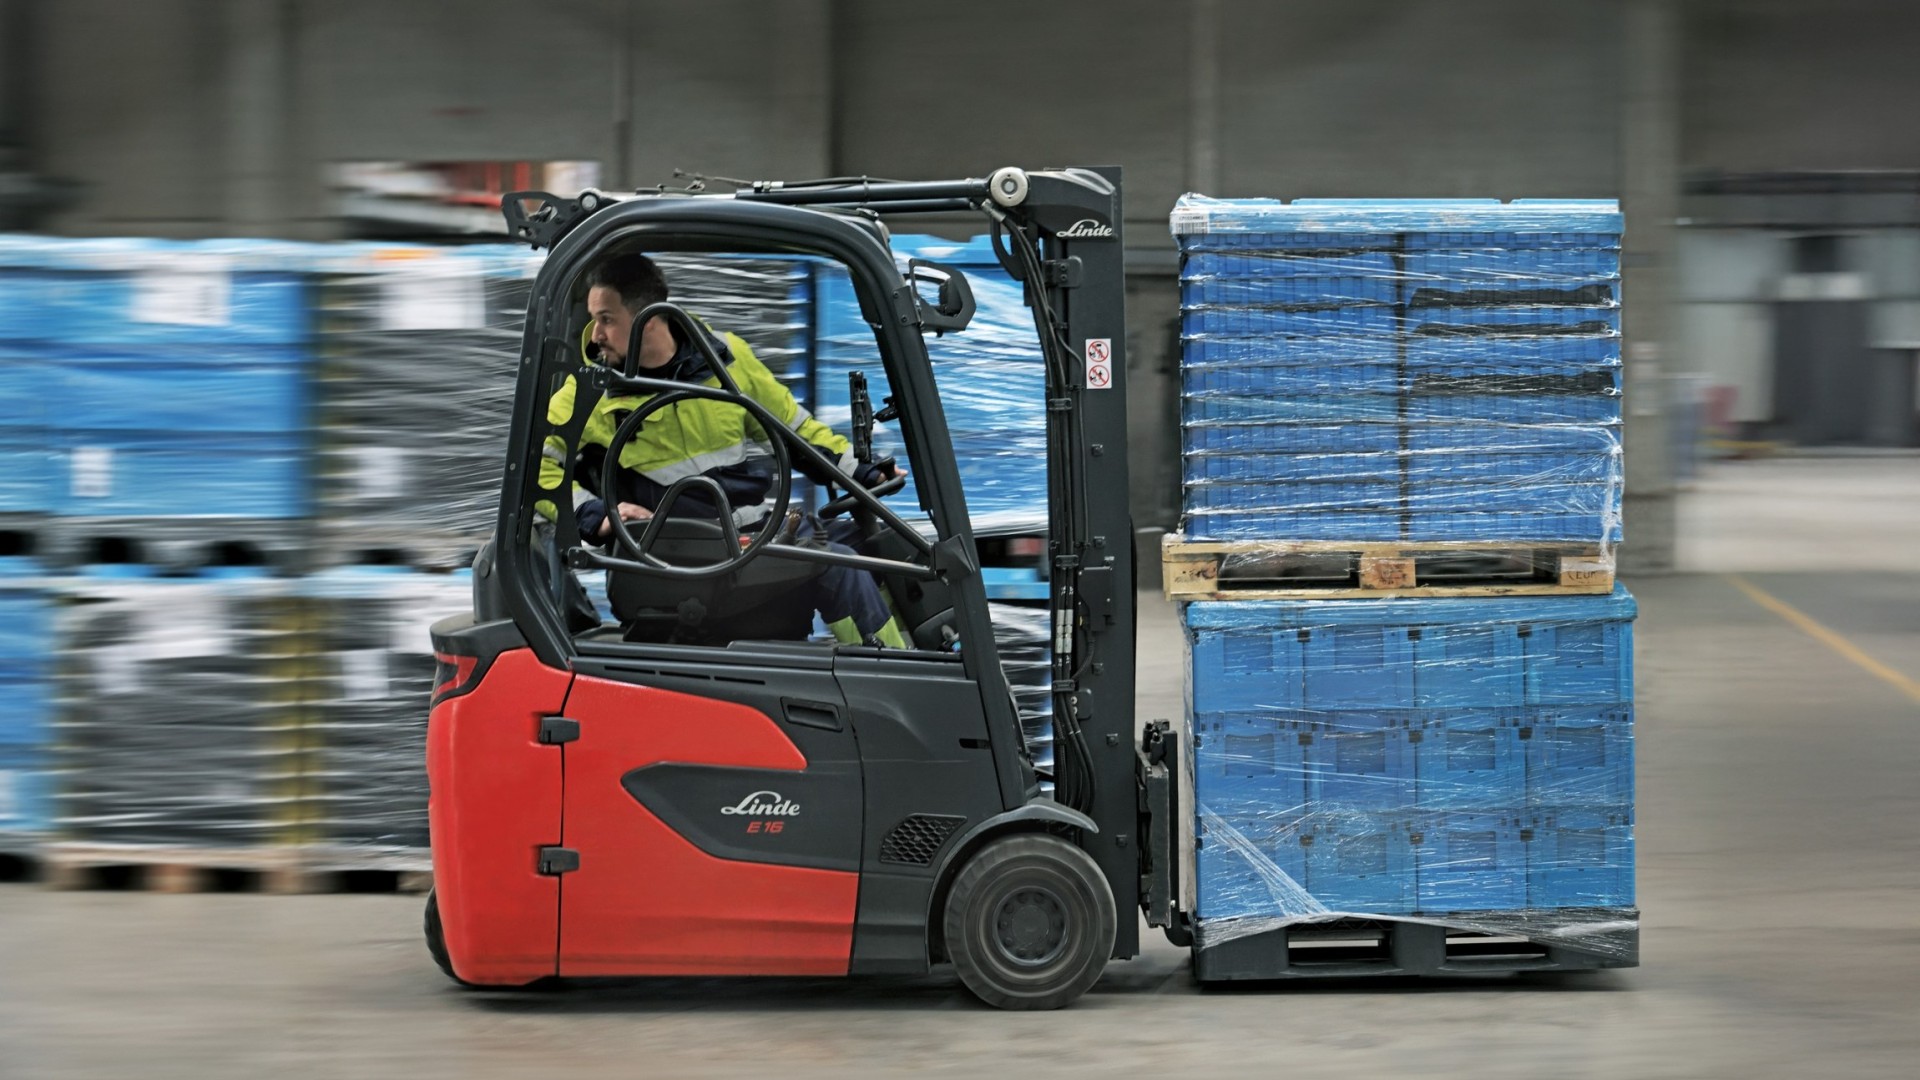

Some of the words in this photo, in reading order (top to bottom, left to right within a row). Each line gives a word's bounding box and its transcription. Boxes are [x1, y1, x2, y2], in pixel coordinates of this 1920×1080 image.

[1056, 219, 1112, 237] Linde
[721, 791, 800, 816] Linde
[747, 821, 762, 833] E
[765, 821, 784, 833] 16
